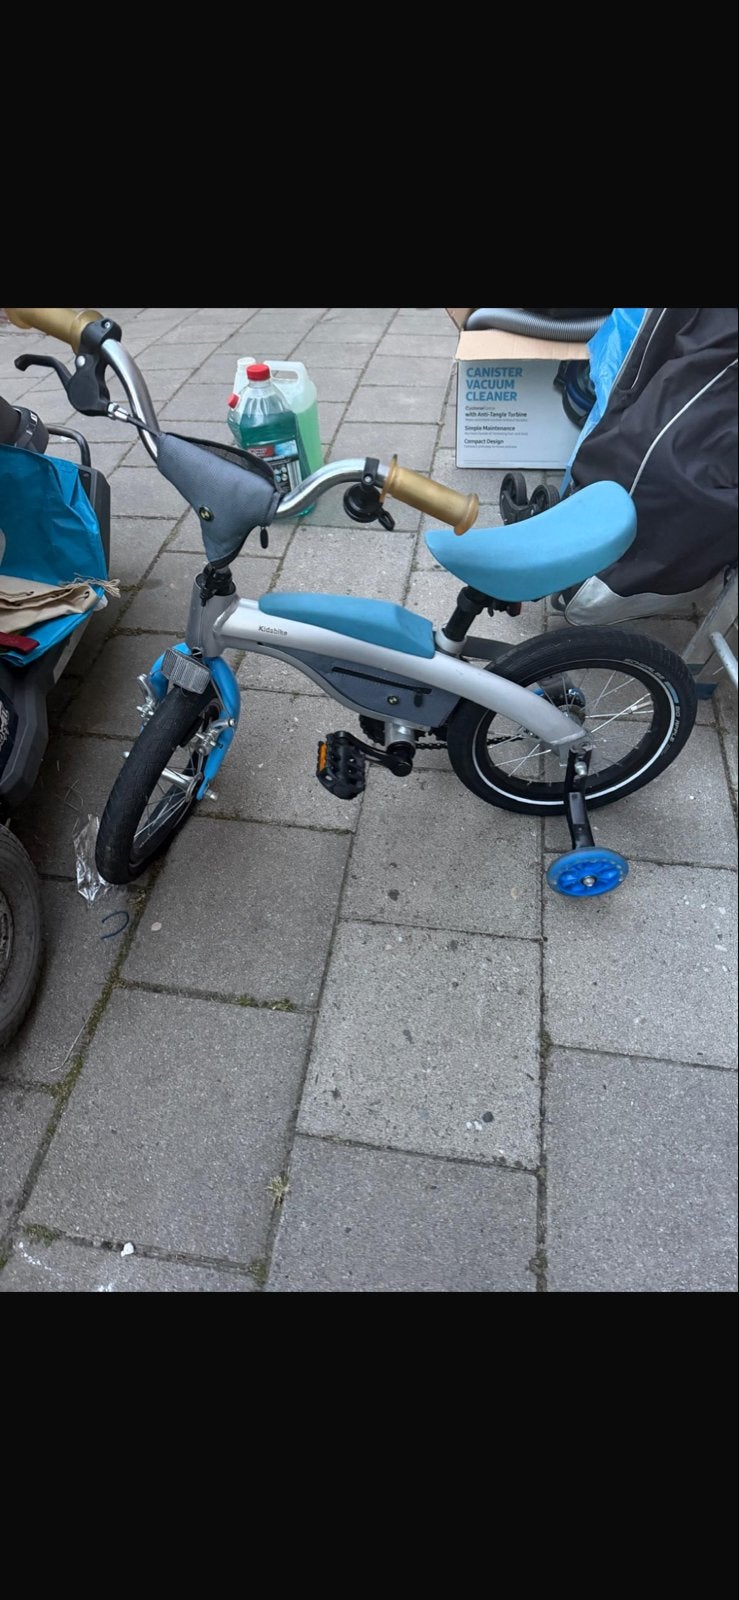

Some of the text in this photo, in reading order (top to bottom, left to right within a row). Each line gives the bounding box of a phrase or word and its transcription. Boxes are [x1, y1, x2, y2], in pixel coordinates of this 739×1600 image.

[466, 367, 523, 377] CANISTER
[466, 379, 515, 389] VACUUM
[465, 391, 518, 401] CLEANER
[257, 625, 288, 636] Kidsbike
